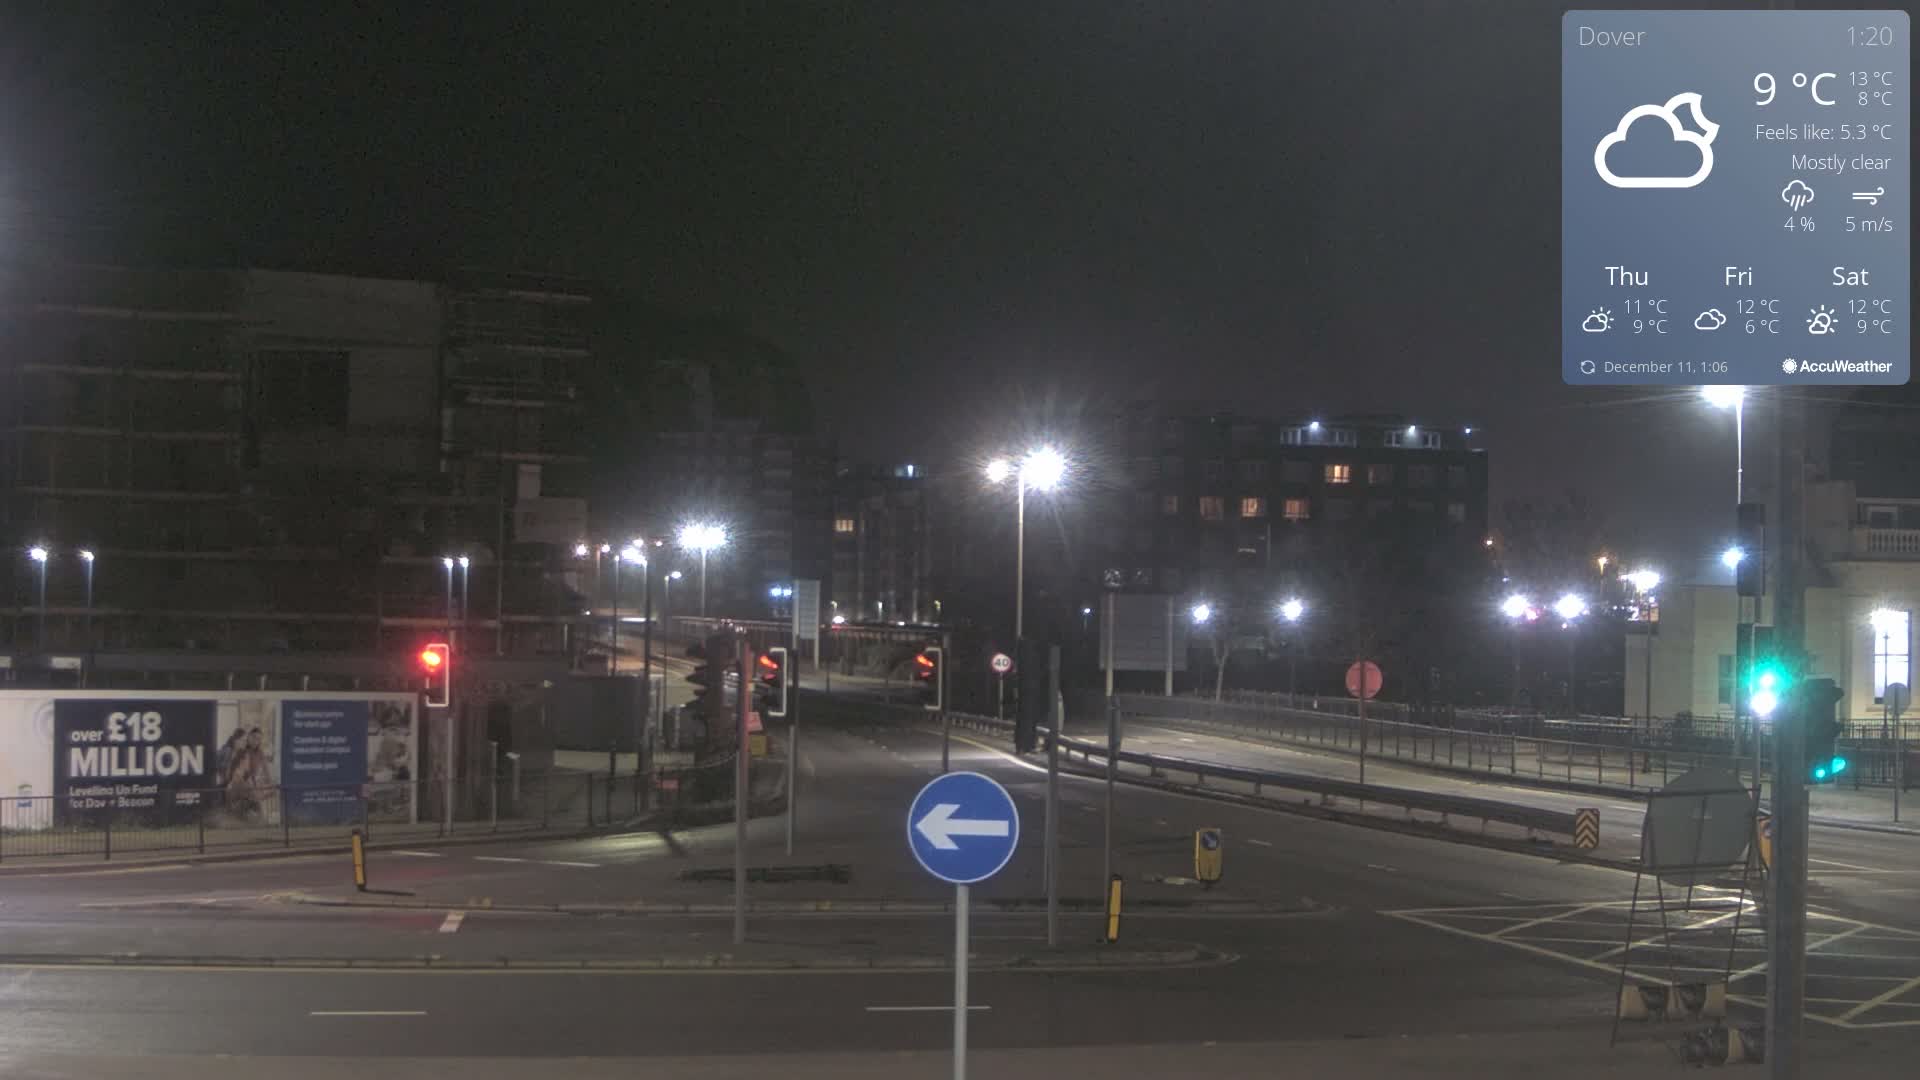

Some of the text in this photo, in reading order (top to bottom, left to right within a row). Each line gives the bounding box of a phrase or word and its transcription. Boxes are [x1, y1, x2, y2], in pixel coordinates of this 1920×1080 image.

[71, 711, 162, 742] over £18
[71, 745, 203, 777] MILLION
[116, 784, 130, 797] Up
[132, 783, 158, 795] Fund
